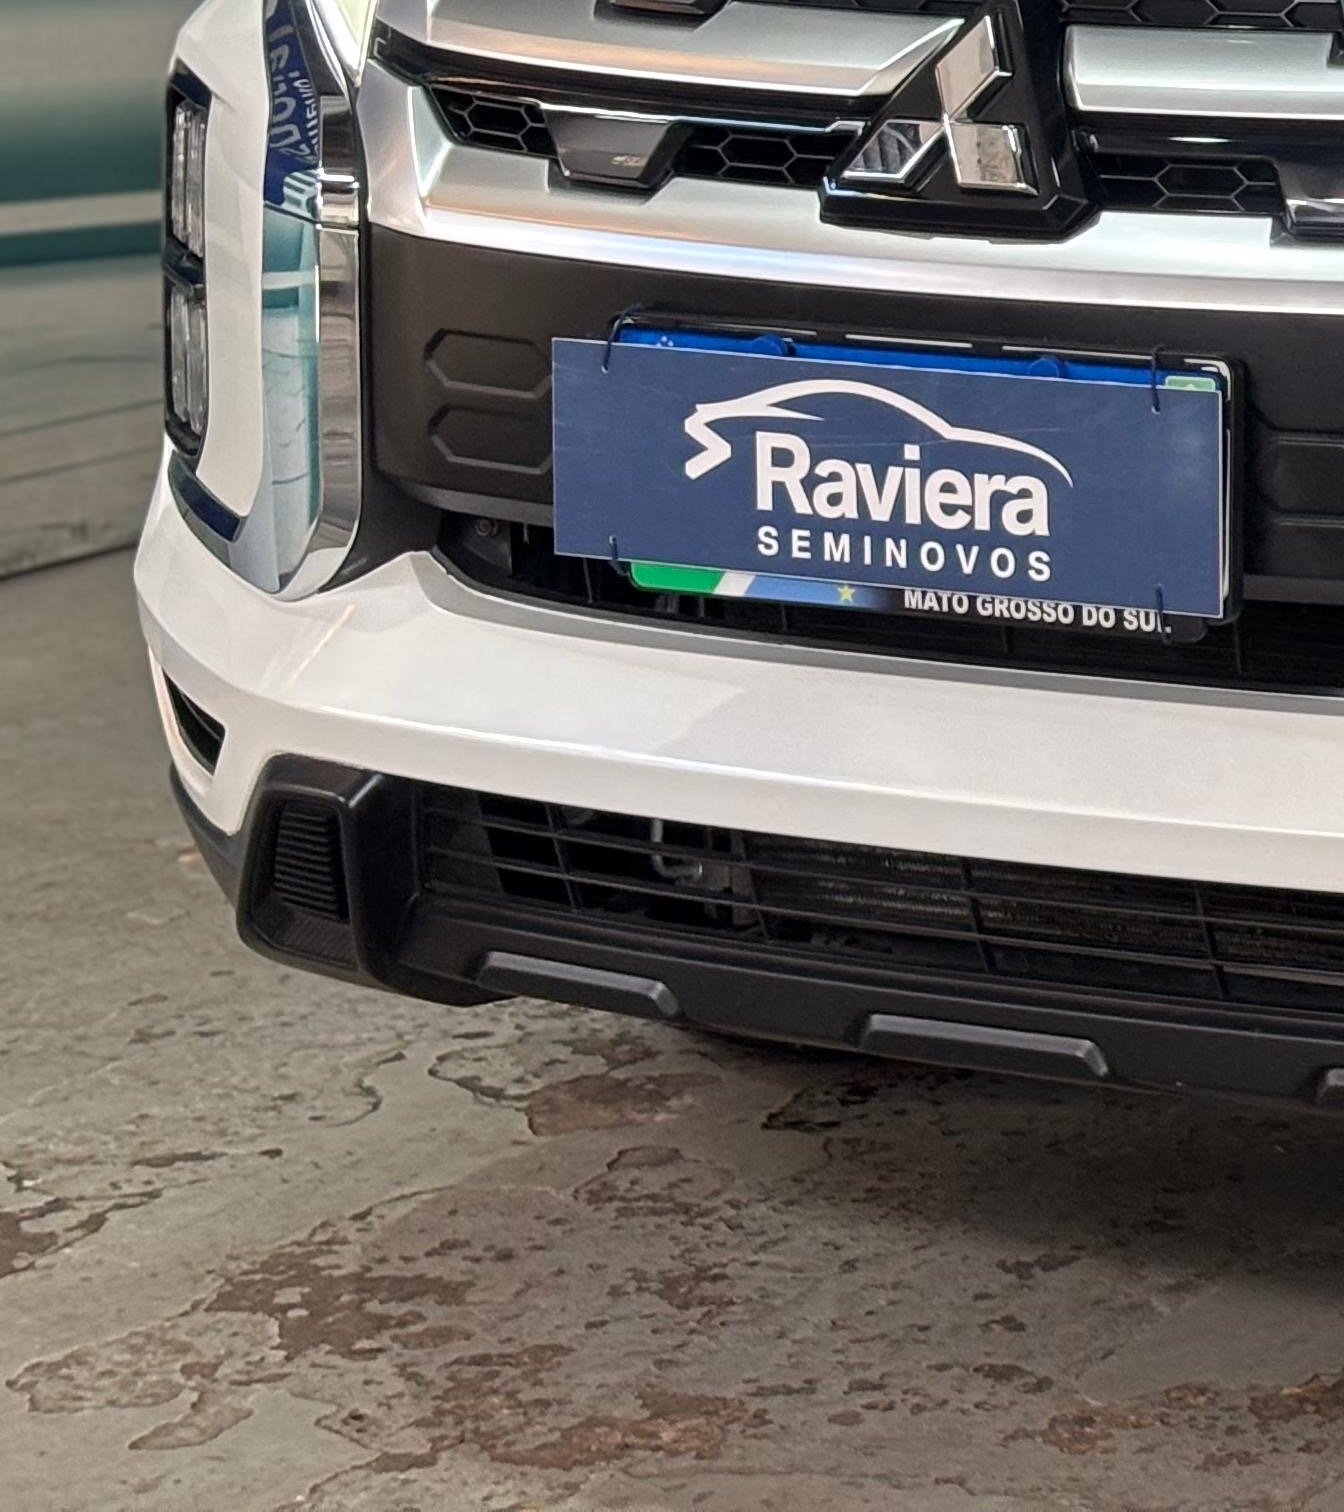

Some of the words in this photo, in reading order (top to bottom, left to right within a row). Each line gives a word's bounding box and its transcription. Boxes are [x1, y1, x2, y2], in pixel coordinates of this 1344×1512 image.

[756, 431, 1050, 537] Raviera
[757, 526, 1051, 582] SEMINOVOS
[904, 589, 969, 615] MATO
[976, 595, 1075, 624] GROSSO
[1082, 604, 1116, 628] DO
